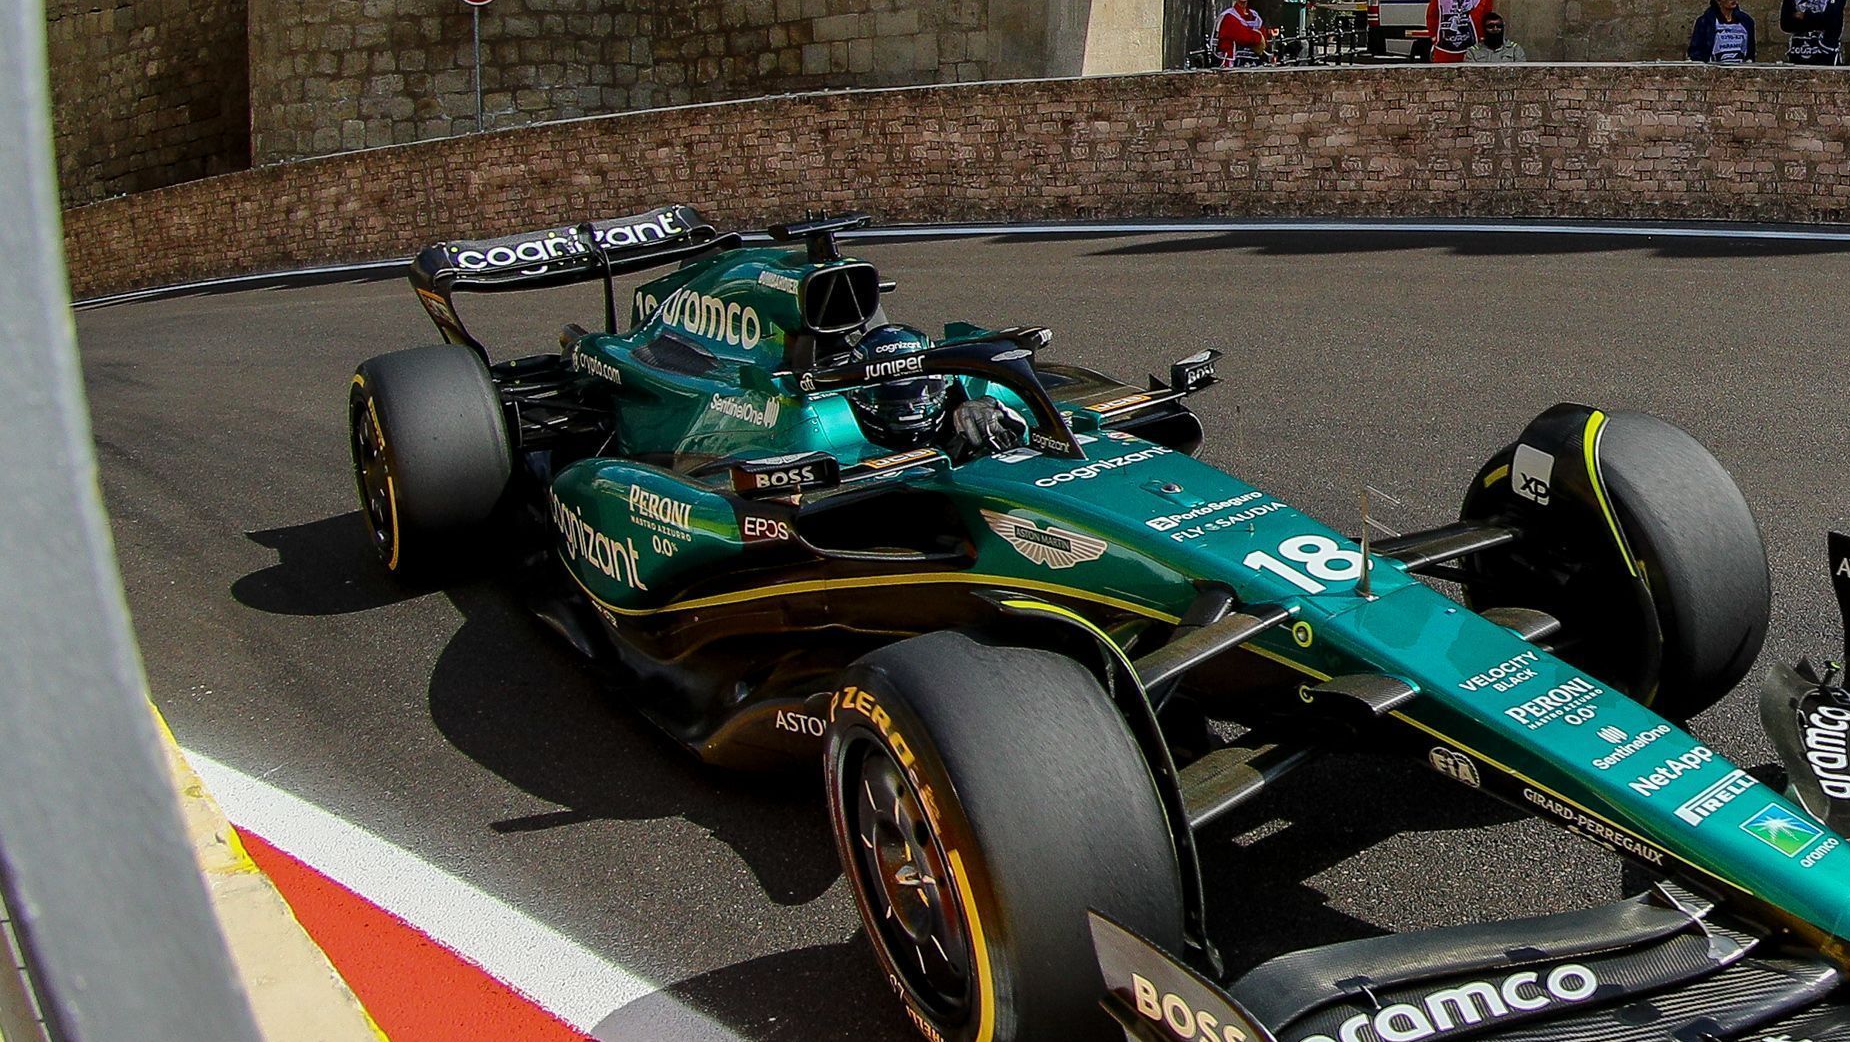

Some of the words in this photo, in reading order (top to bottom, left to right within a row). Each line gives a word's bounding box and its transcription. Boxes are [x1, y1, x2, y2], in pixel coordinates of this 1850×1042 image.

[662, 288, 761, 350] aramco
[875, 341, 922, 353] cognizant
[579, 354, 622, 385] crypto.com
[710, 393, 764, 426] SentinelOne
[1031, 432, 1070, 454] cognizant
[756, 466, 815, 489] BOSS
[1034, 445, 1174, 488] cognizant
[629, 484, 693, 530] PERONI
[1170, 525, 1206, 543] FLY
[1217, 501, 1288, 529] SAUDIA
[1243, 535, 1374, 595] 18
[1458, 650, 1541, 692] VELOCITY
[1492, 668, 1538, 693] BLACK
[1504, 676, 1596, 725] PERONI
[1527, 709, 1564, 731] NASTRO
[776, 710, 826, 736] ASTO
[842, 686, 916, 767] ZERO
[1592, 724, 1672, 770] SentinelOne
[1628, 745, 1714, 797] NetApp
[1523, 788, 1665, 867] GIRARD-PERREGAUX
[1800, 837, 1840, 868] aramco
[1300, 963, 1598, 1042] ramco
